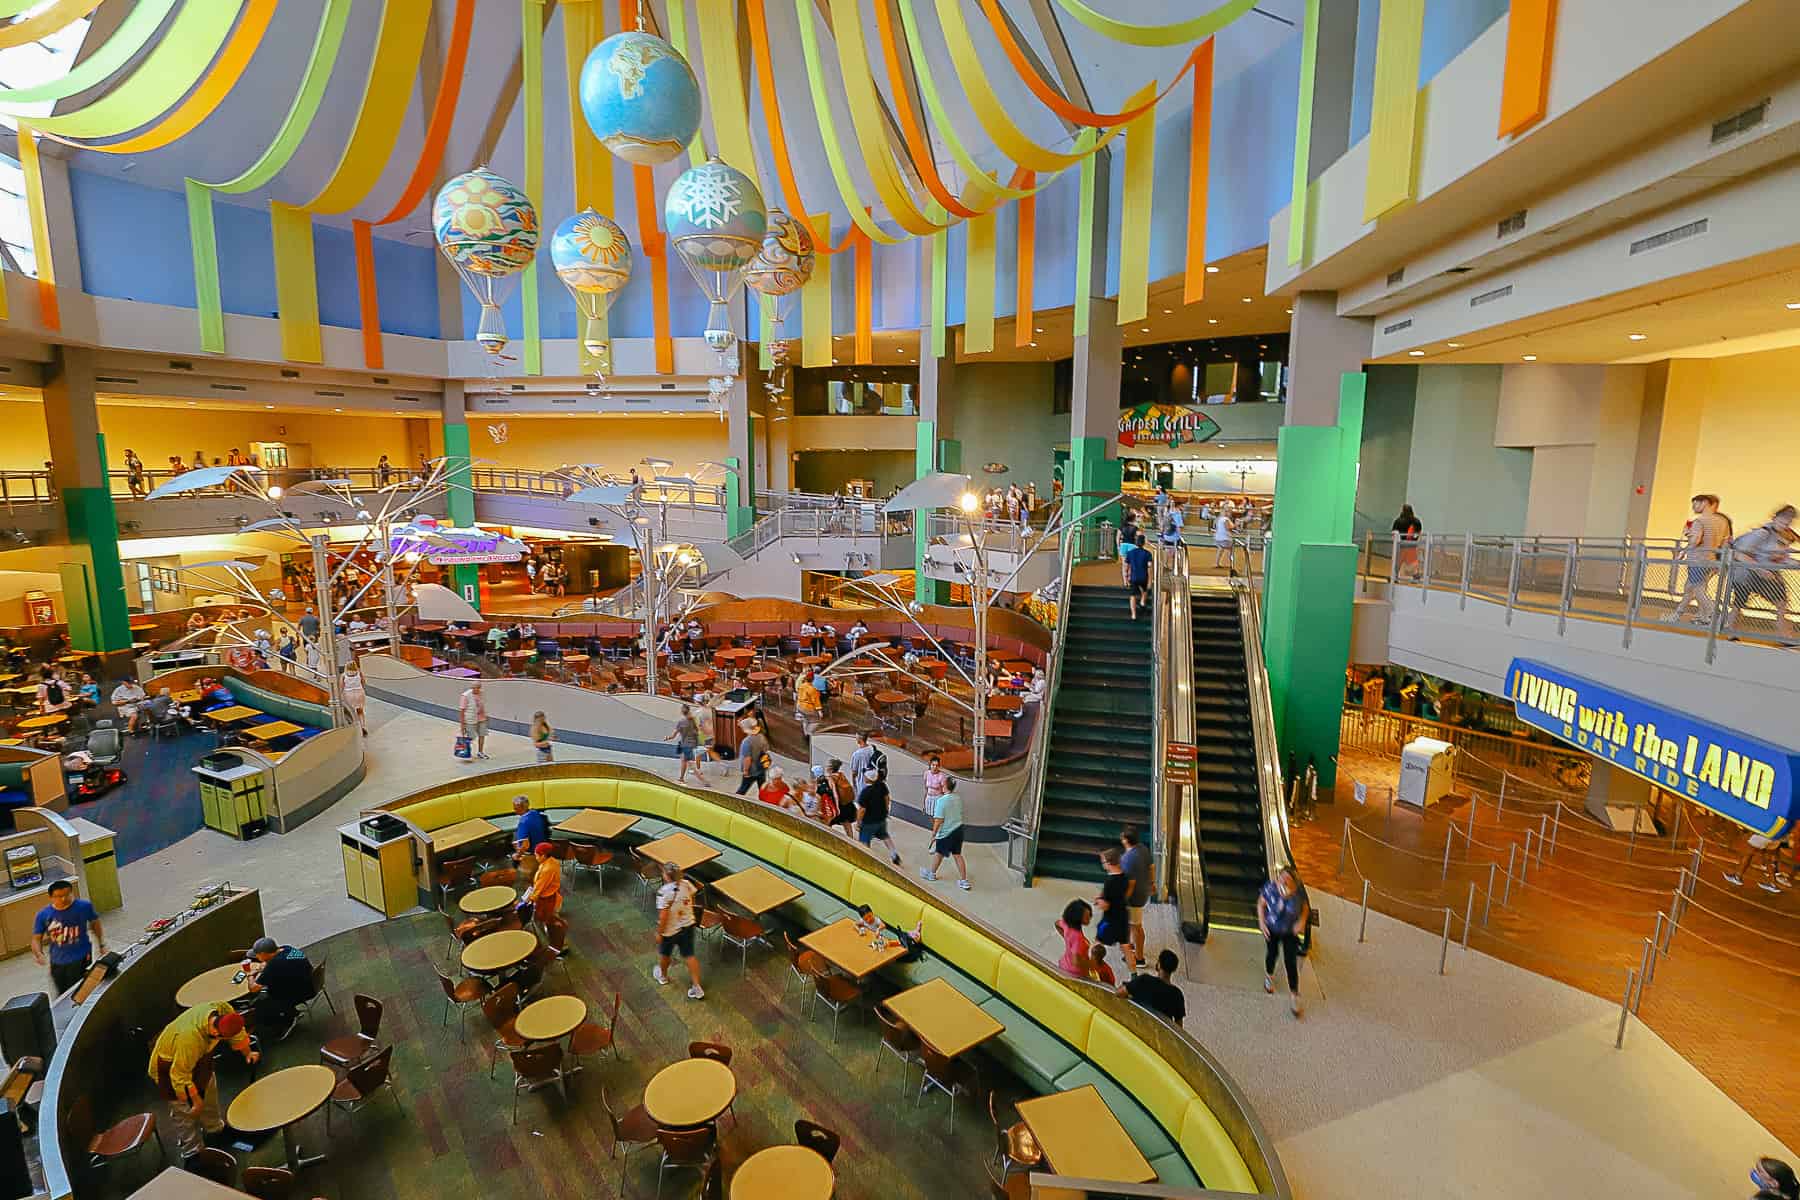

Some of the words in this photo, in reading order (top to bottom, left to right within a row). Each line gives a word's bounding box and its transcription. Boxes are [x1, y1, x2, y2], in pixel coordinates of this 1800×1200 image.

[1512, 669, 1577, 724] LIVING
[1578, 704, 1630, 748] with
[1632, 724, 1680, 769] the
[1682, 735, 1776, 810] LAND
[1562, 726, 1620, 757] BOAT
[1635, 758, 1699, 797] RIDE
